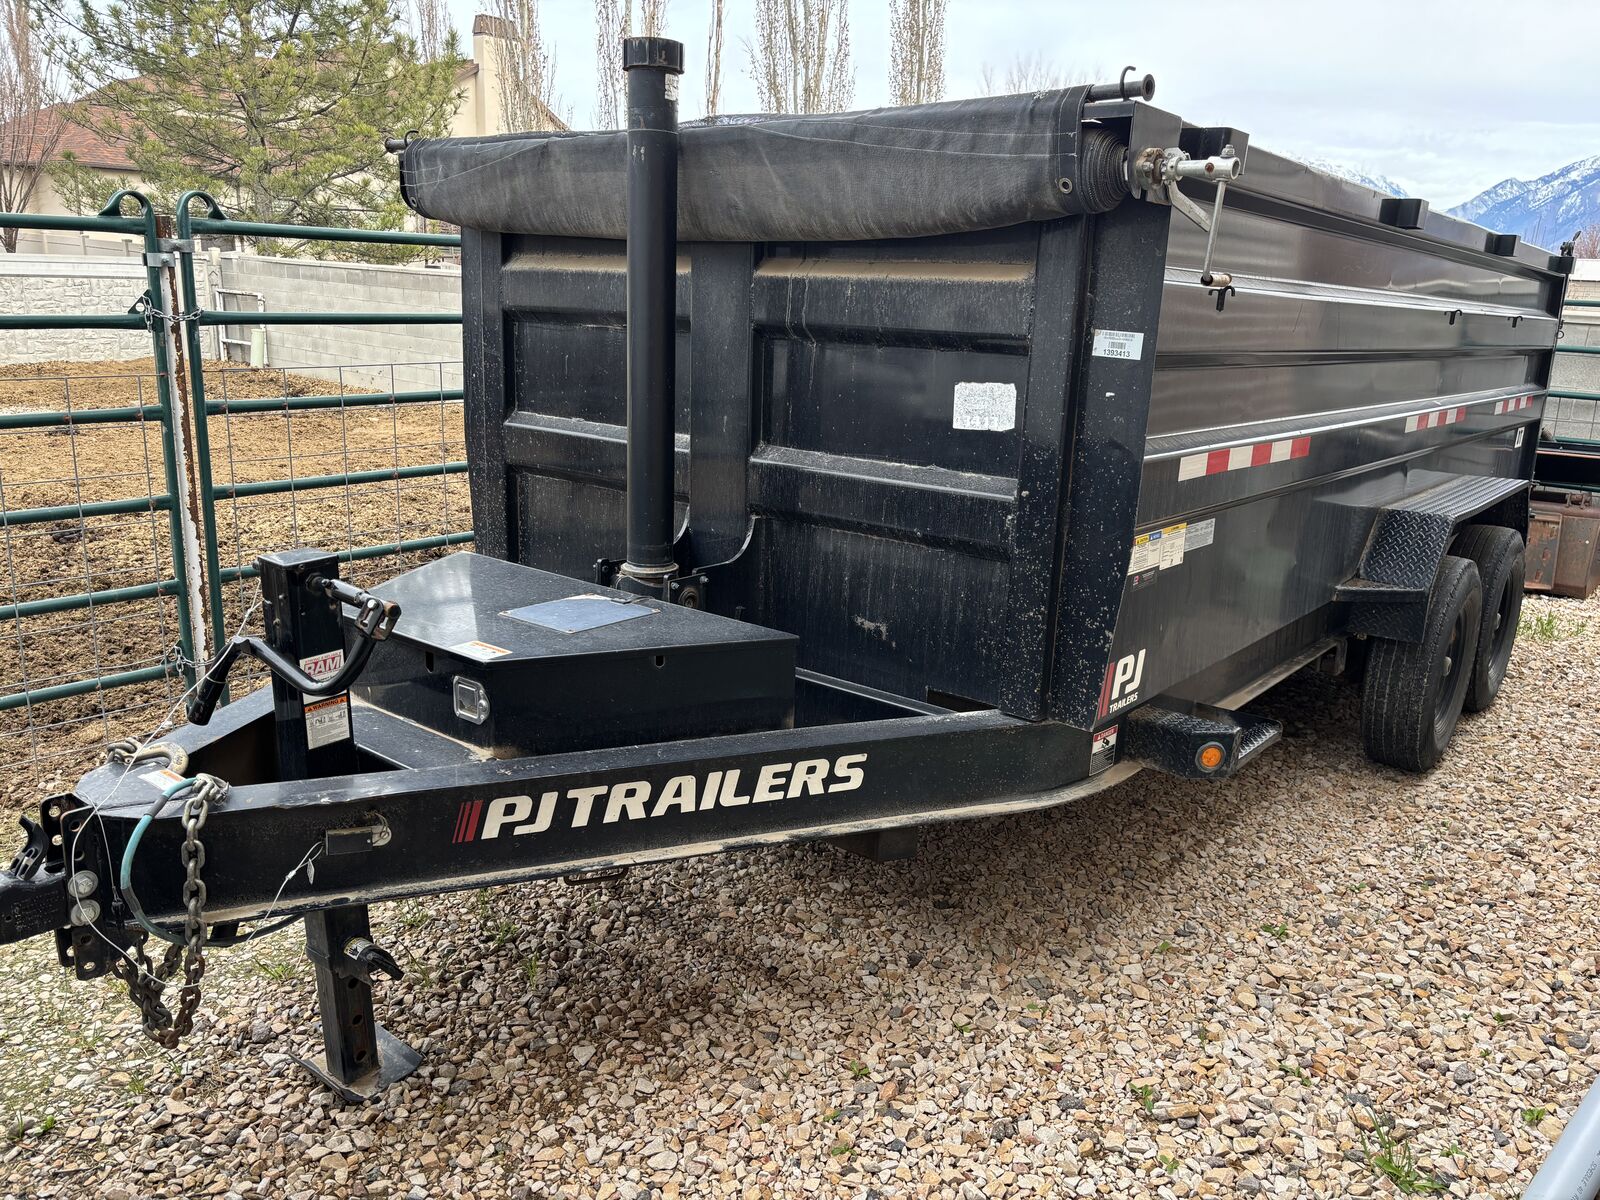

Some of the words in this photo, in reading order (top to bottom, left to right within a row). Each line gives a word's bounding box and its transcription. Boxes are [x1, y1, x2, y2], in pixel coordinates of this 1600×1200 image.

[1103, 349, 1131, 358] 1393413
[304, 655, 341, 676] RAM
[1111, 648, 1146, 700] PJ
[312, 699, 339, 710] WARNING
[1109, 692, 1138, 714] TRAILERS
[480, 791, 559, 840] PJ
[566, 752, 868, 828] TRAILERS
